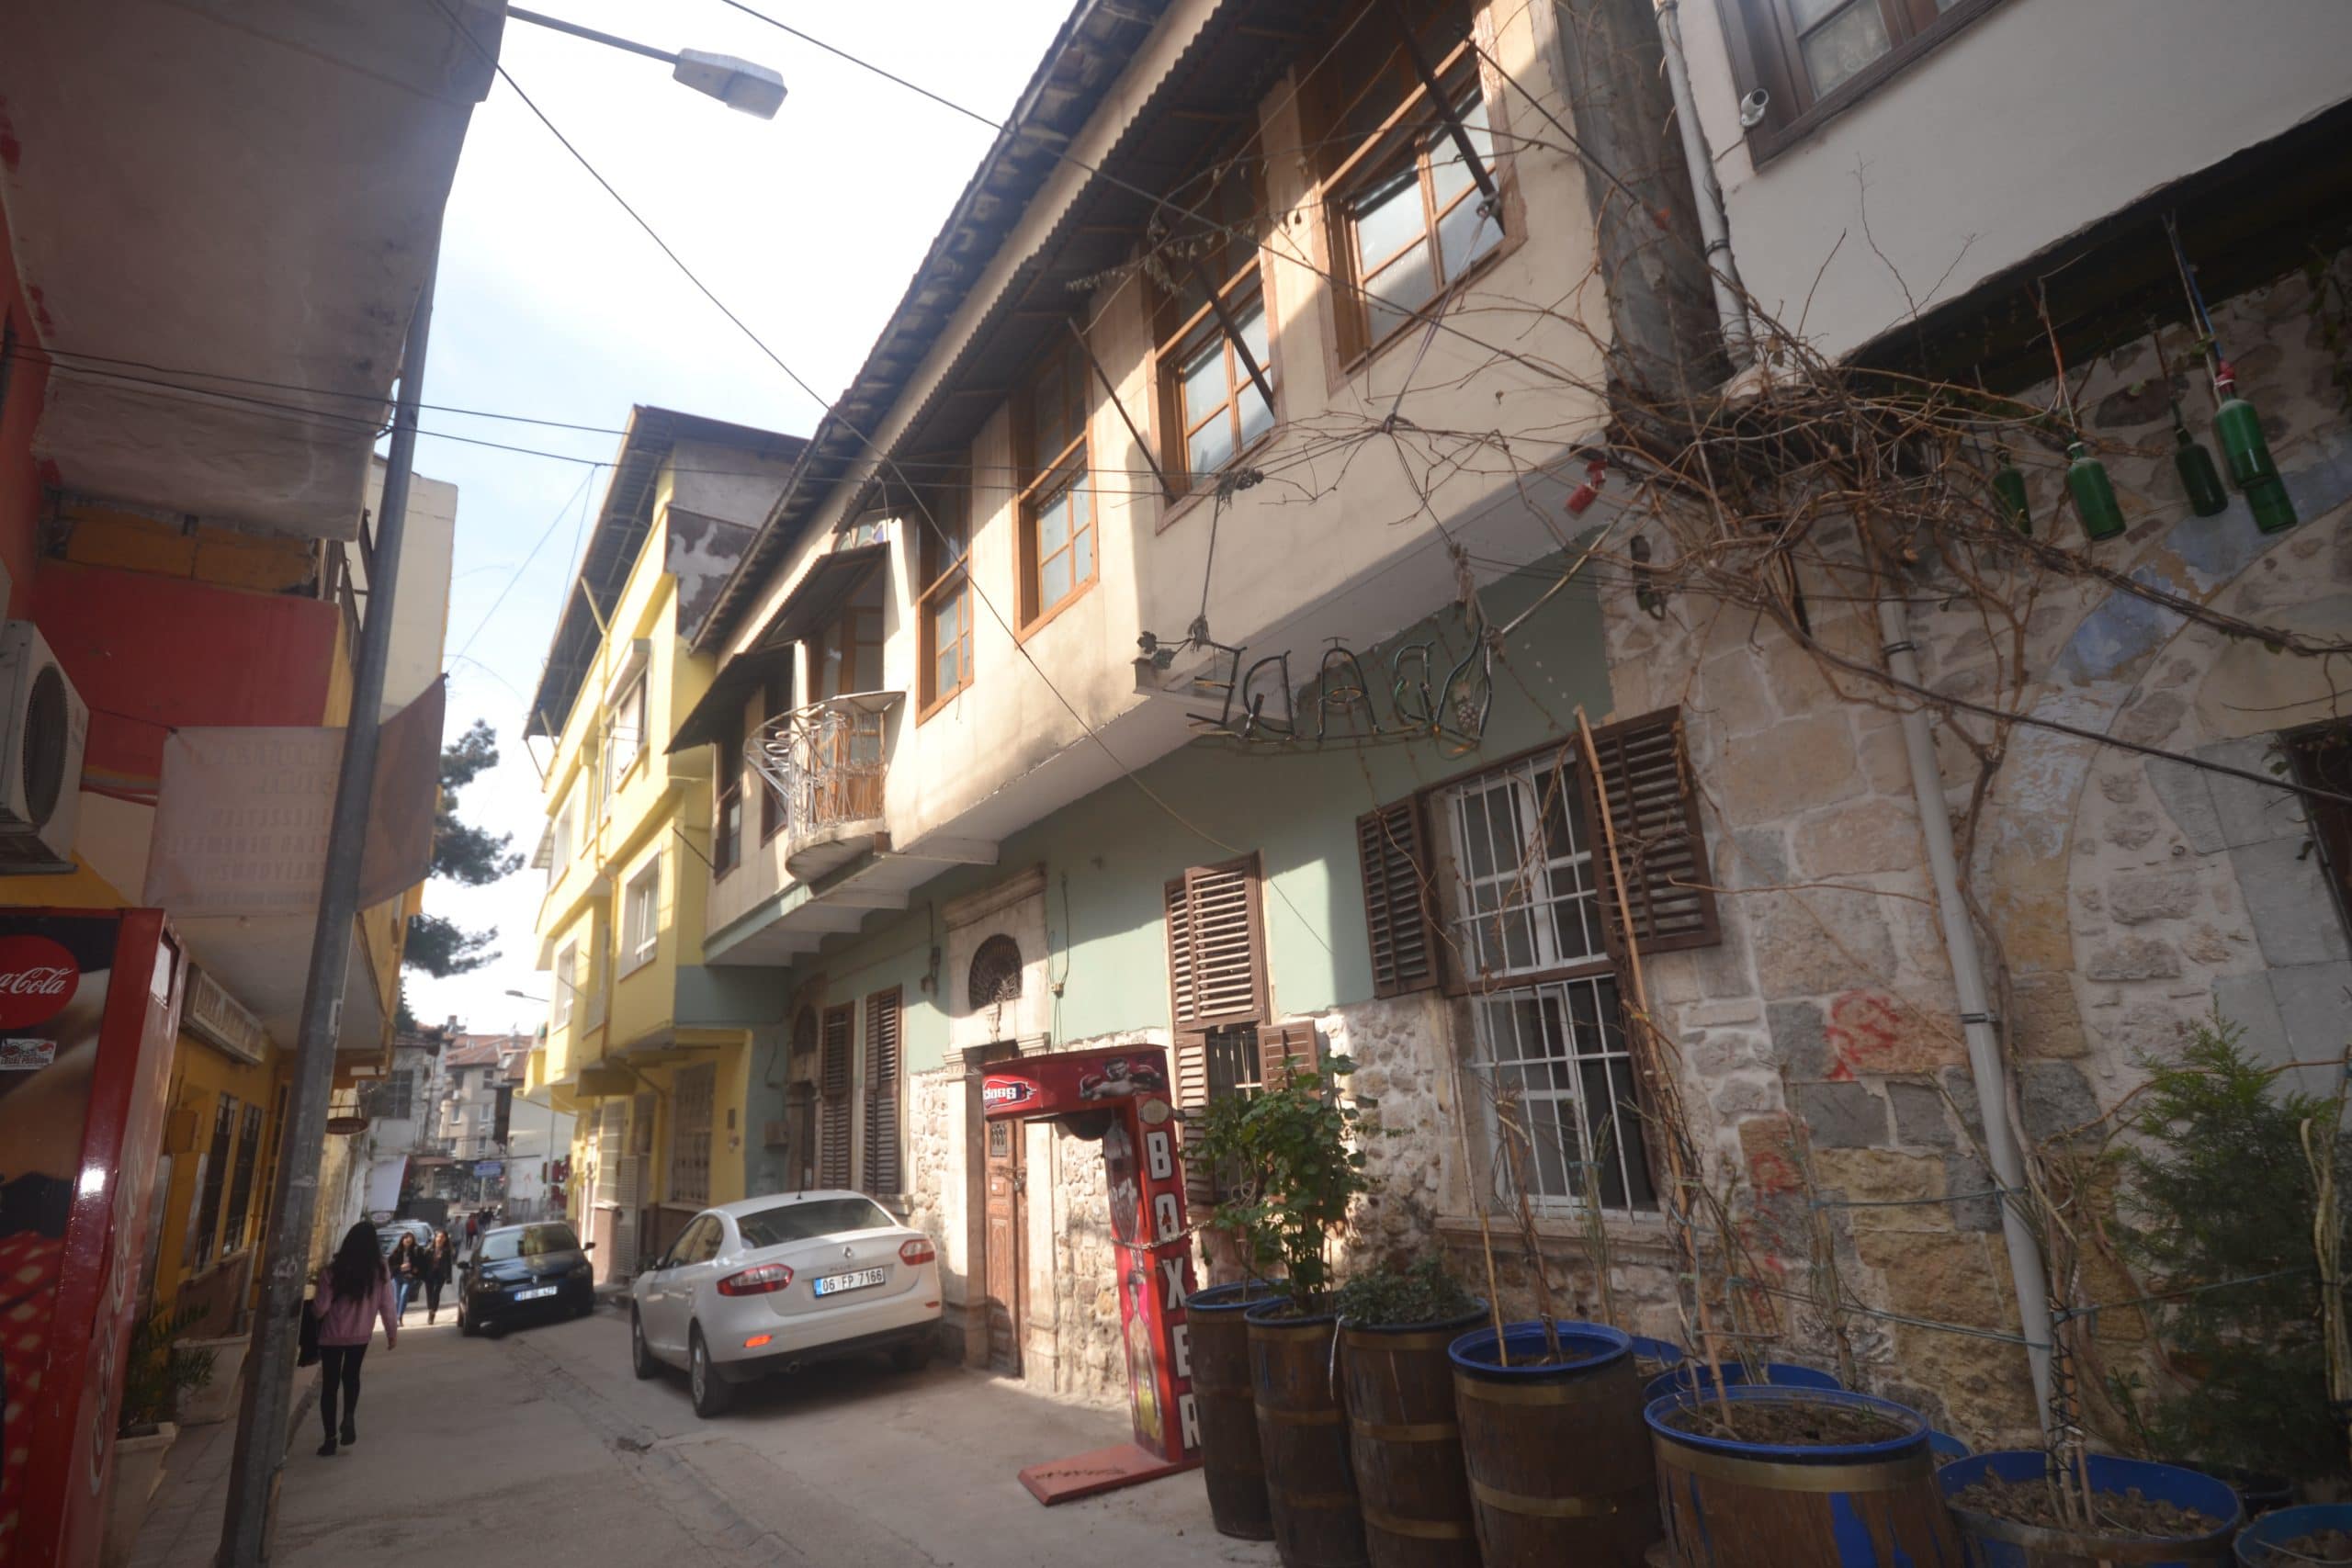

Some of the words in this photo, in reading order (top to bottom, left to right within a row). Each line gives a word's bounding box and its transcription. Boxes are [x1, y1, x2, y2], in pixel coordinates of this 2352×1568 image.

[822, 1279, 835, 1292] 06
[842, 1275, 854, 1290] FP
[858, 1270, 882, 1284] 7166
[1148, 1131, 1202, 1450] BOXER
